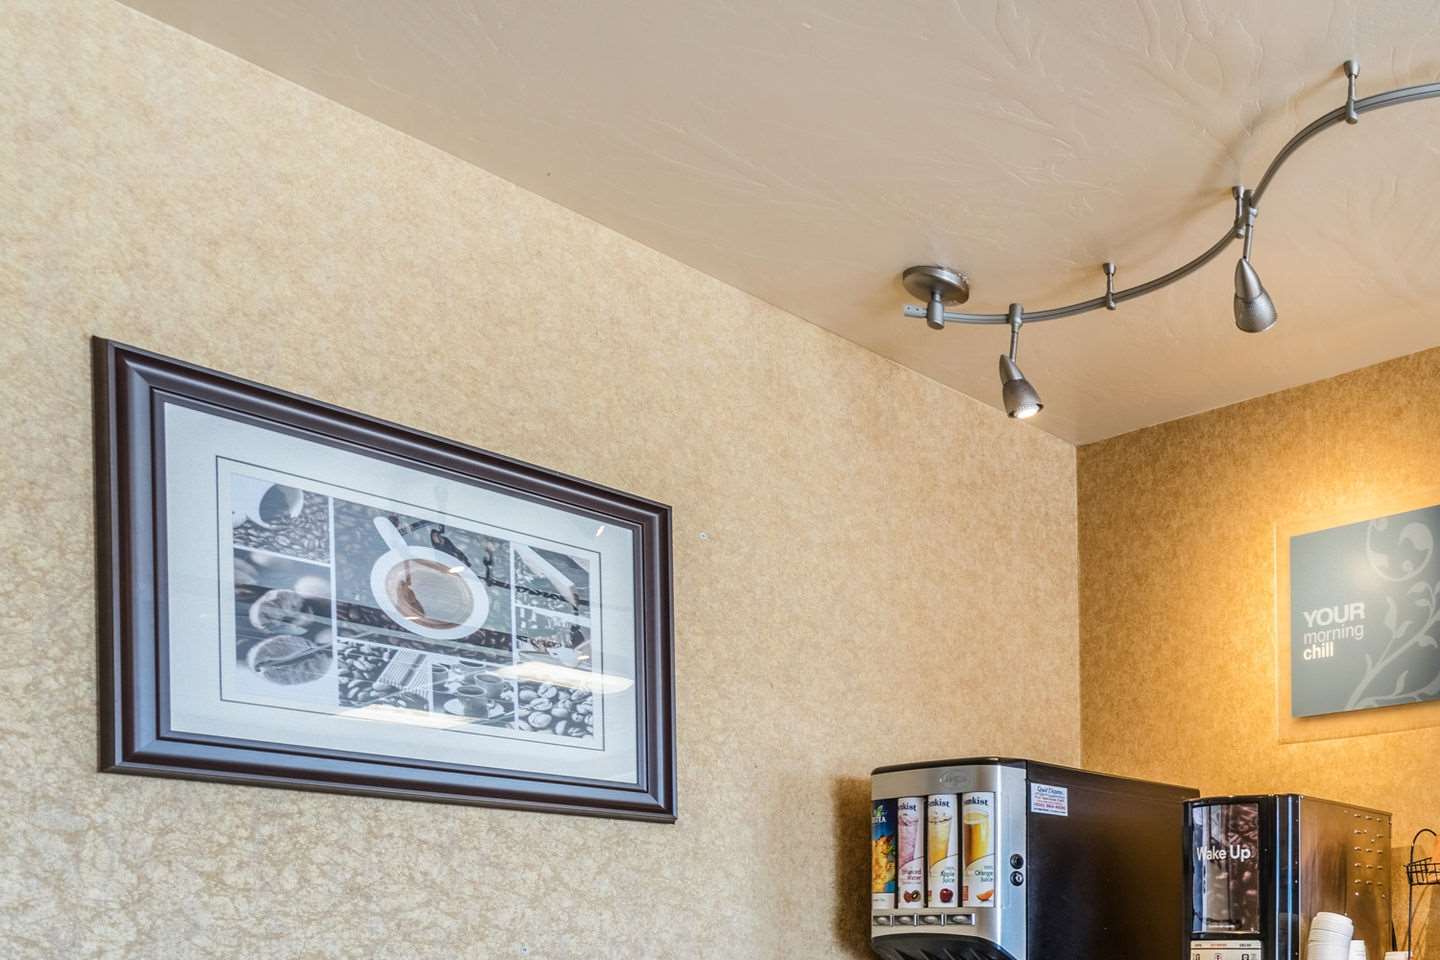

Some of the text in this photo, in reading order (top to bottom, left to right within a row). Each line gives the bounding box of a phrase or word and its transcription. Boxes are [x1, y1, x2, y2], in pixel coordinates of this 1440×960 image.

[1303, 602, 1366, 628] YOUR
[1303, 624, 1365, 645] morning
[1303, 641, 1334, 660] chill
[1197, 844, 1251, 863] Wake Up
